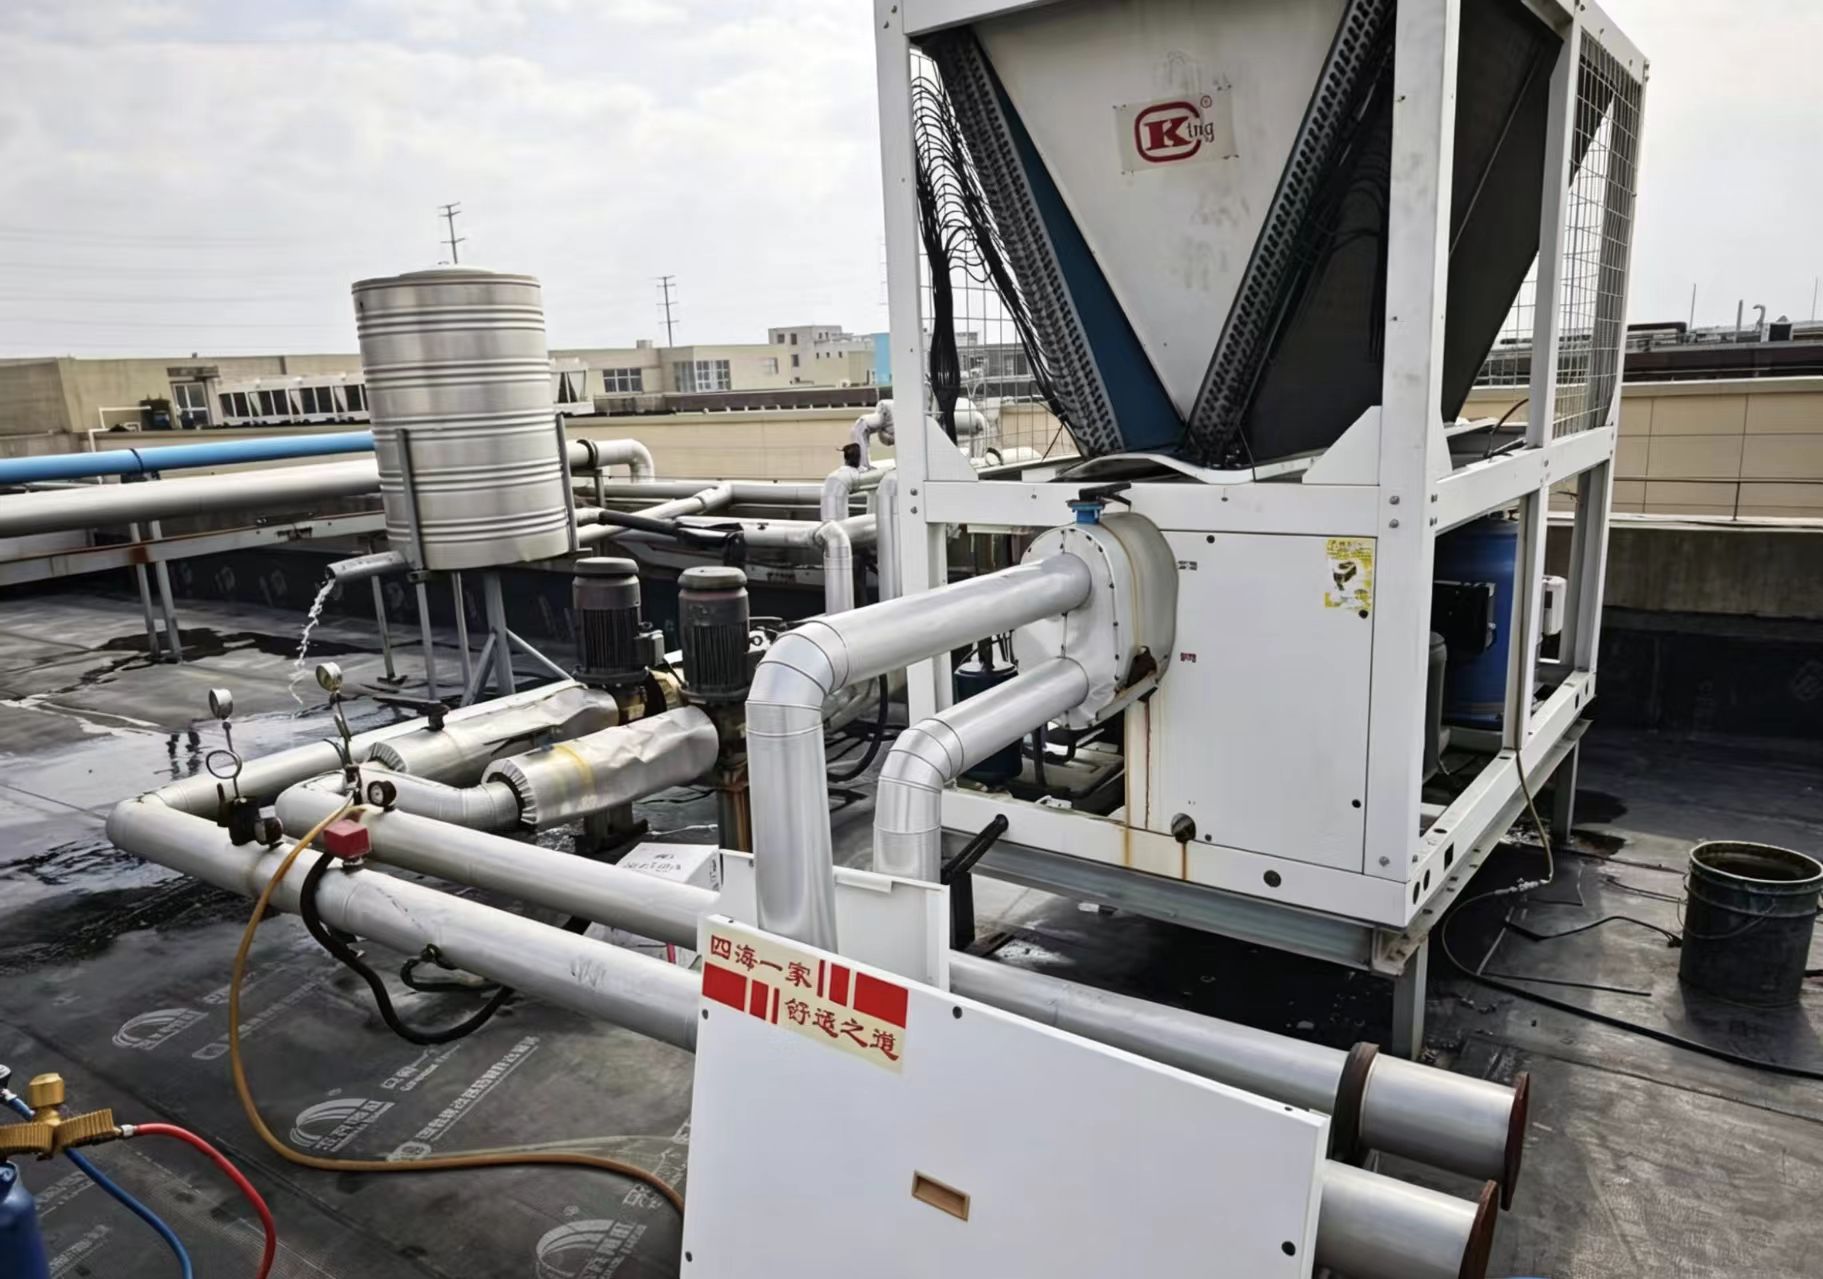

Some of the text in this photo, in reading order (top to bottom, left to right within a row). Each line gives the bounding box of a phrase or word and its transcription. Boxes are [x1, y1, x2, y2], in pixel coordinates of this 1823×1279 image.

[710, 935, 812, 989] 四海一家
[784, 998, 899, 1061] 舒适之道
